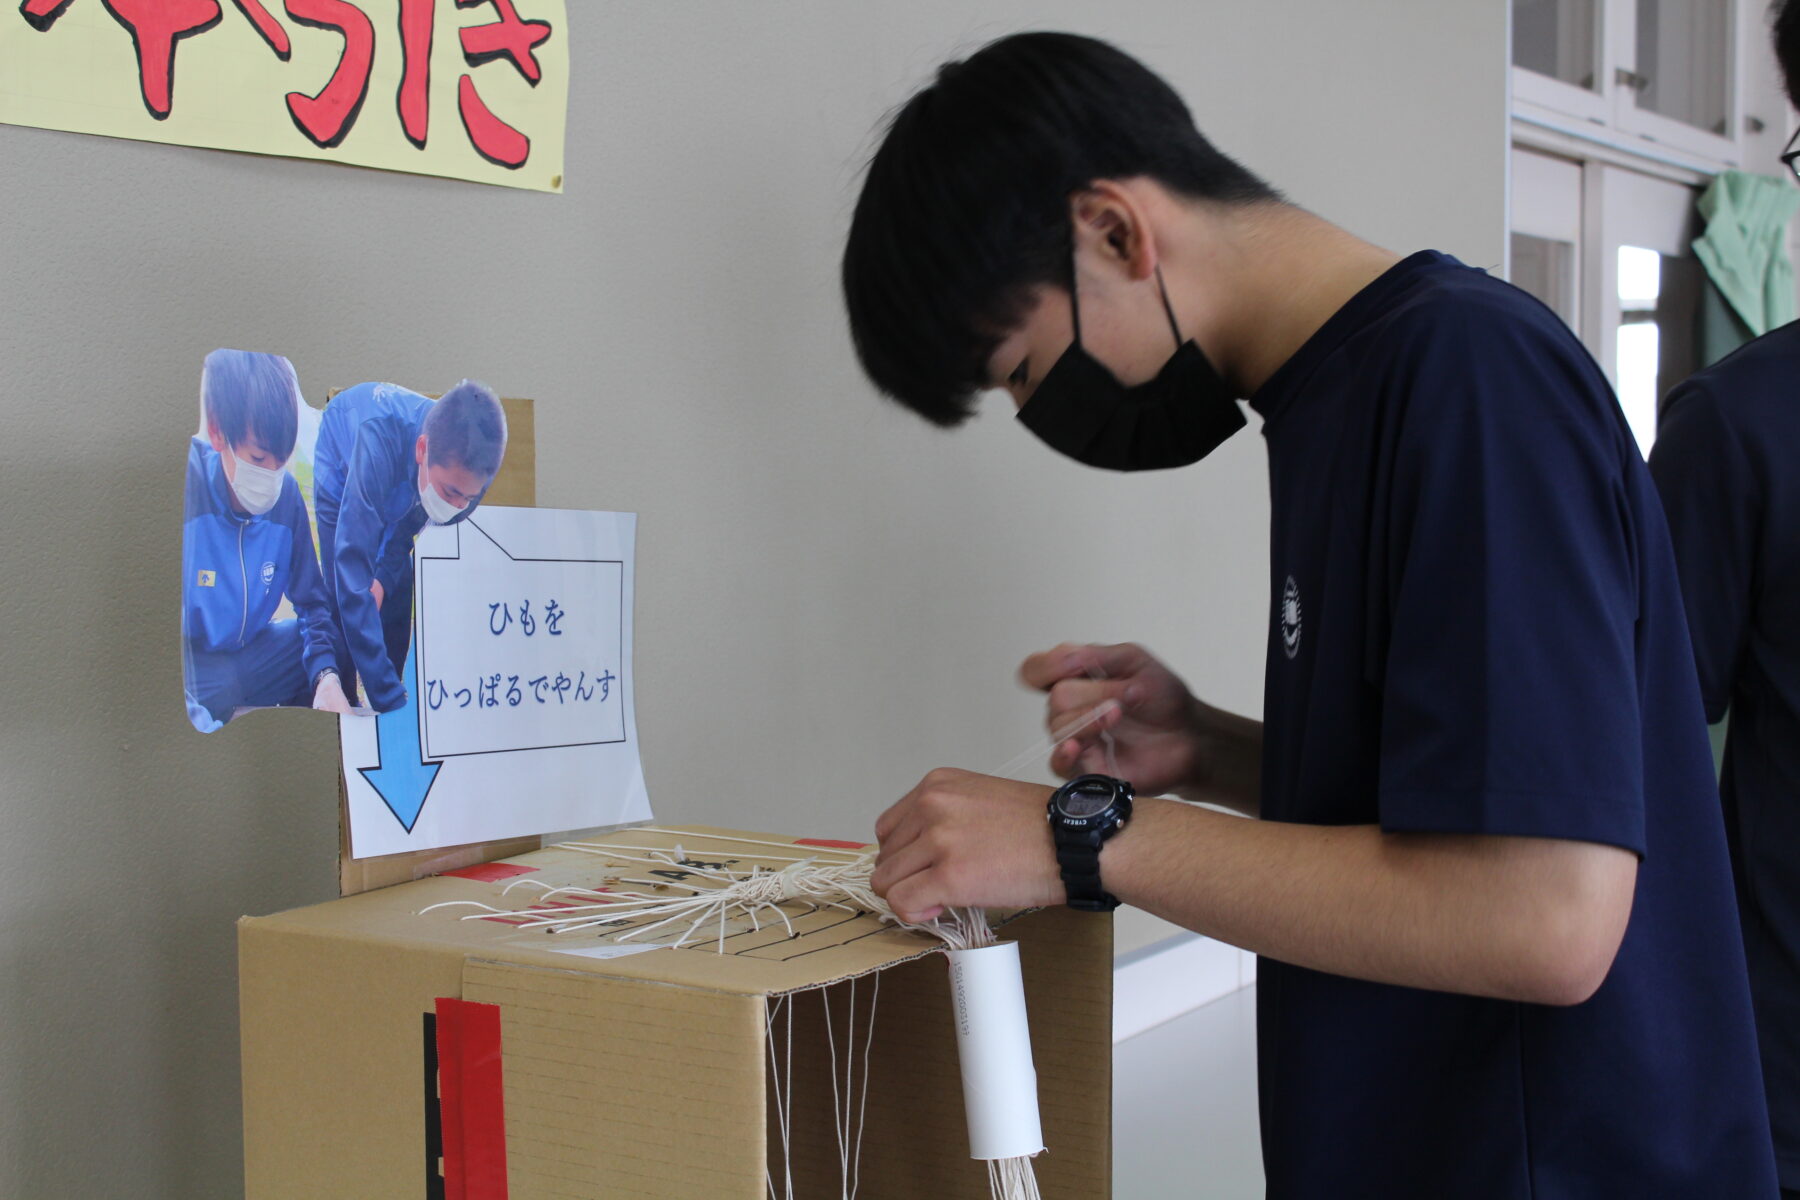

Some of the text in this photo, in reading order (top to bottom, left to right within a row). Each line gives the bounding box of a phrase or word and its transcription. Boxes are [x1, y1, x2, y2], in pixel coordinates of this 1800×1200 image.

[488, 599, 565, 637] ひもを
[426, 669, 616, 710] ひっぱるでやんす
